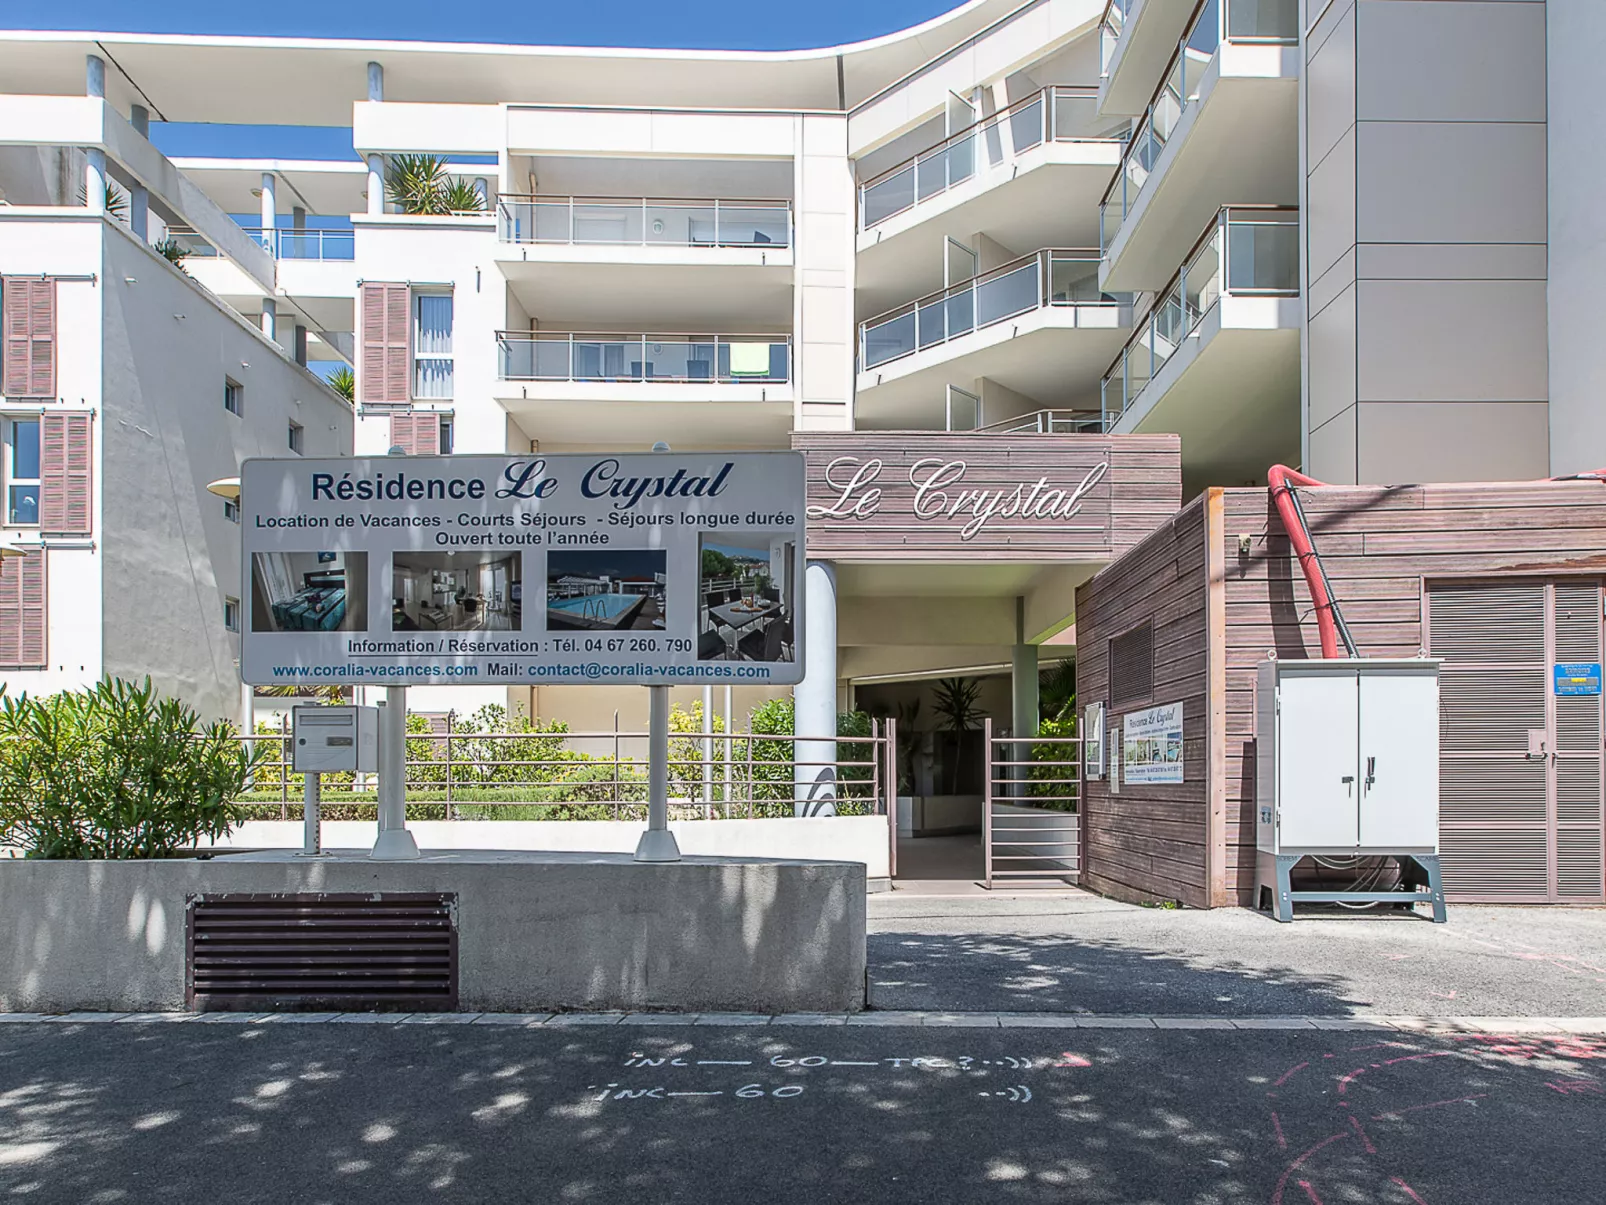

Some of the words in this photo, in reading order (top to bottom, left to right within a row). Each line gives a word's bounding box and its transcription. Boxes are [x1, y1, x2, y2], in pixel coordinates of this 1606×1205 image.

[312, 472, 486, 500] Résidence
[494, 459, 559, 499] Le
[580, 458, 735, 511] Crystal
[806, 456, 882, 518] Le
[909, 457, 1108, 540] Crystal
[256, 514, 329, 528] Location
[334, 514, 355, 527] de
[360, 513, 441, 528] Vacances
[457, 512, 515, 527] Courts
[520, 511, 586, 529] Séjours
[607, 510, 674, 529] Séjours
[680, 511, 740, 528] longue
[745, 510, 796, 525] durée
[435, 531, 493, 545] Ouvert
[498, 531, 542, 545] toute
[348, 640, 435, 653] Information
[448, 638, 539, 653] Réservation
[552, 637, 580, 652] Tél.
[584, 638, 603, 652] 04
[607, 638, 625, 652] 67
[629, 638, 661, 652] 260.
[665, 638, 693, 652] 790
[272, 663, 479, 677] www.coralia-vacances.com
[487, 663, 523, 677] Mail:
[527, 662, 771, 679] contact@coralia-vacances.com
[735, 1083, 804, 1098] 60
